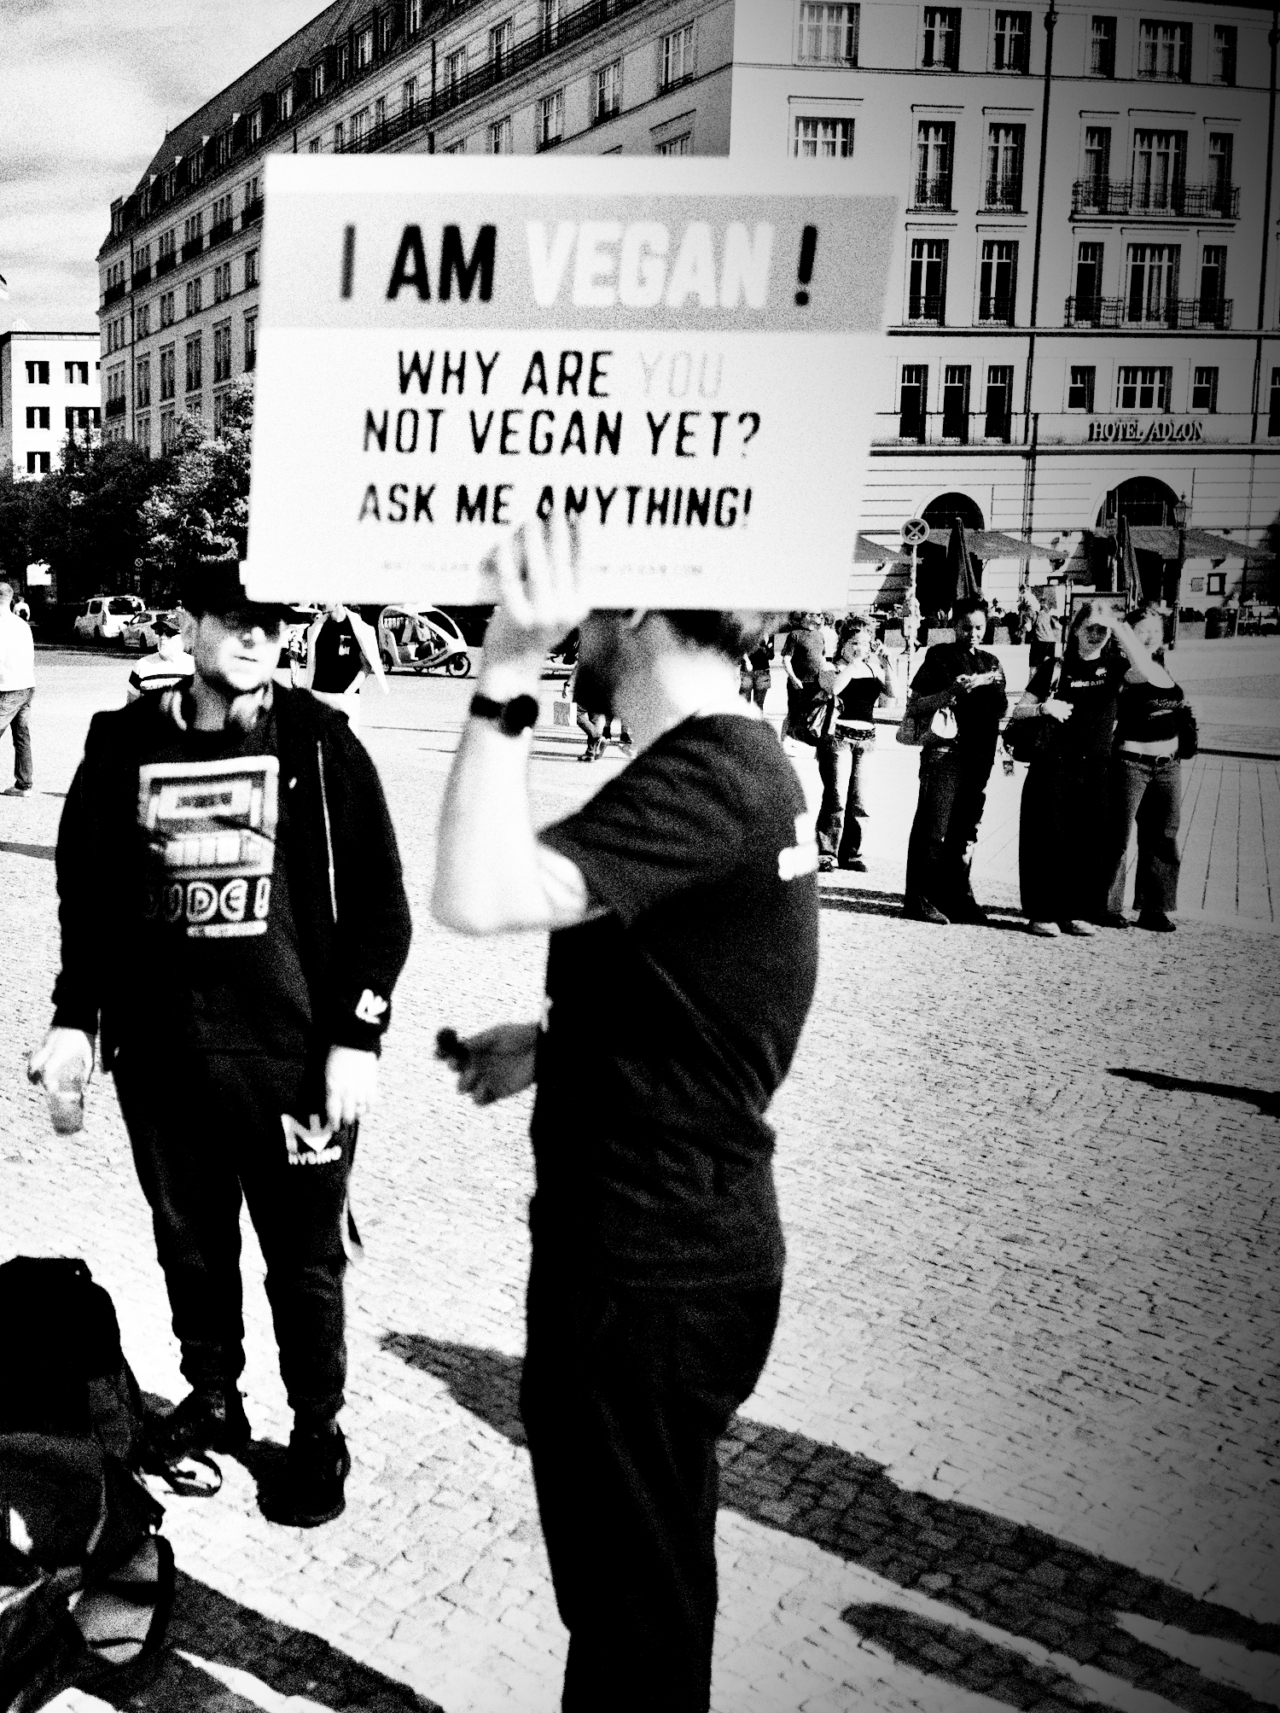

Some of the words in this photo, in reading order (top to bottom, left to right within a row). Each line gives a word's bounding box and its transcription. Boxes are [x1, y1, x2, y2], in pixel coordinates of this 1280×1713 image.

[341, 223, 357, 300] I
[386, 224, 497, 302] AM
[525, 219, 775, 308] VEGAN
[398, 350, 500, 395] WHY
[522, 350, 614, 398] ARE
[639, 350, 725, 398] YOU
[363, 408, 447, 453] NOT
[469, 408, 623, 456] VEGAN
[645, 410, 762, 458] YET?
[1089, 421, 1144, 441] HOTEL
[1147, 421, 1203, 441] ADLON
[357, 483, 437, 524] ASK
[456, 484, 515, 525] ME
[535, 484, 753, 529] ANYTHING!
